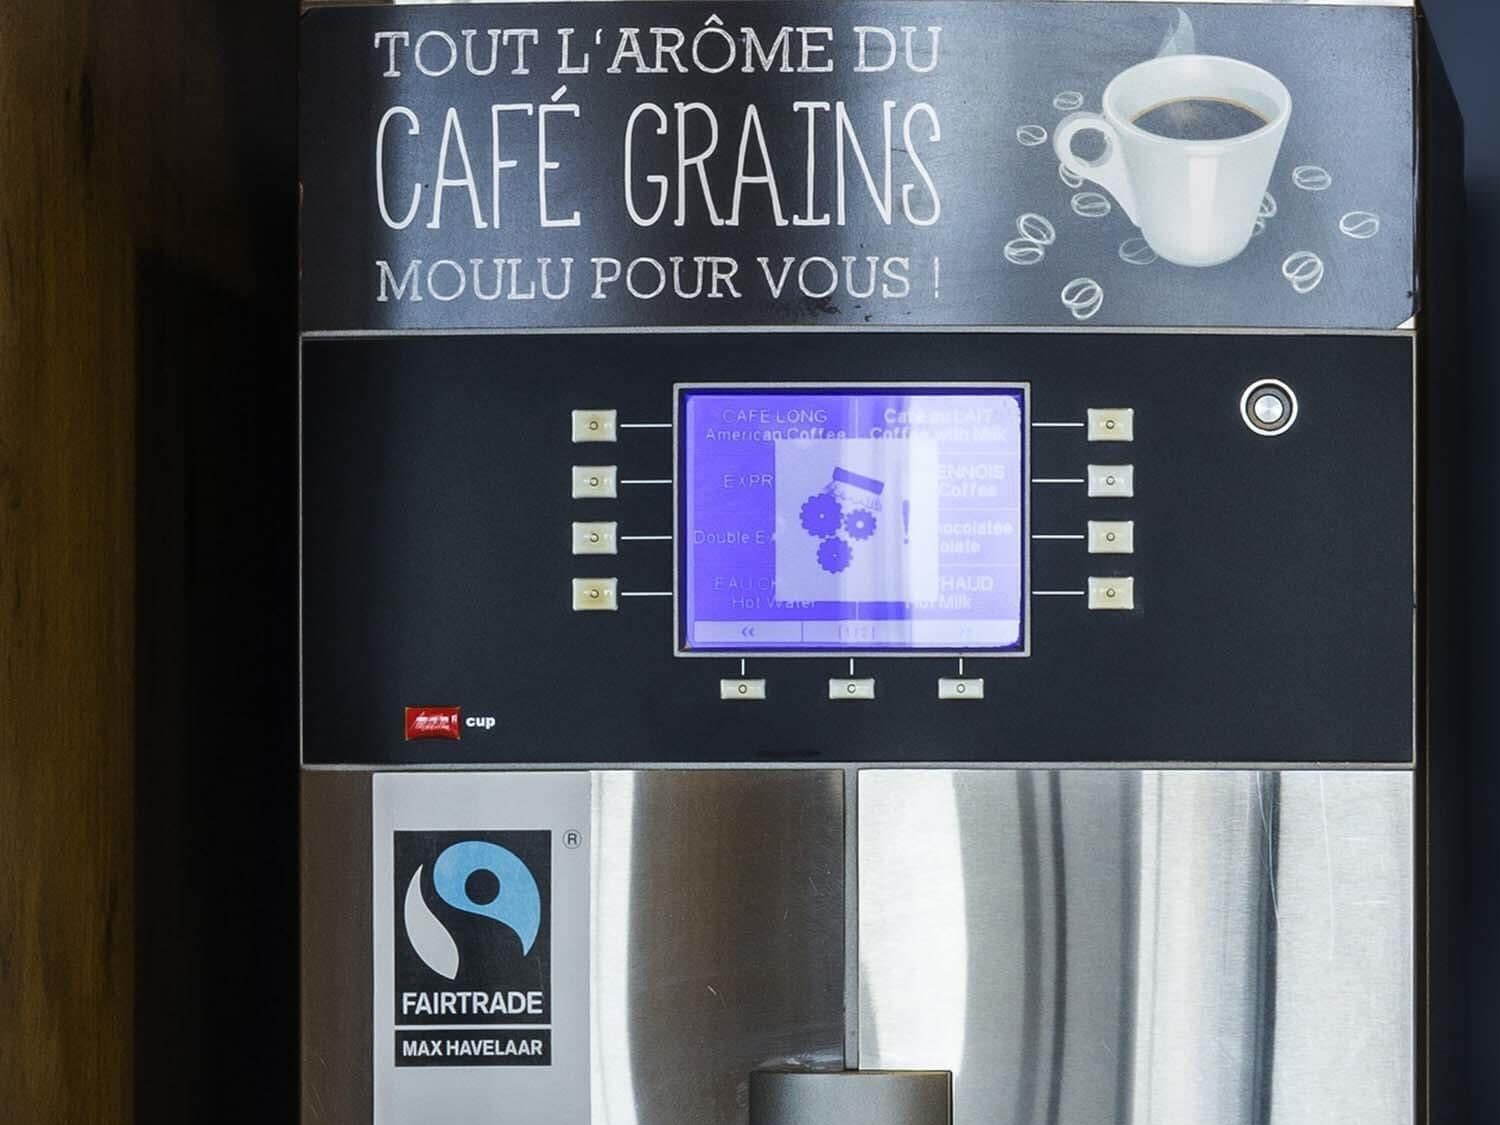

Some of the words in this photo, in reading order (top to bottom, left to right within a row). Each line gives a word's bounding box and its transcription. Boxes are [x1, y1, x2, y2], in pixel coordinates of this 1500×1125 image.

[374, 30, 539, 77] TOUT
[853, 25, 941, 73] DU
[374, 84, 581, 229] CAFÉ
[623, 100, 941, 227] GRAINS
[375, 258, 574, 302] MOULU
[591, 257, 741, 300] POUR
[756, 256, 911, 299] VOUS
[776, 409, 829, 424] LONG
[465, 716, 496, 730] cup
[402, 991, 543, 1015] FAIRTRADE
[402, 1039, 443, 1057] MAX
[446, 1039, 544, 1056] HAVELAAR
